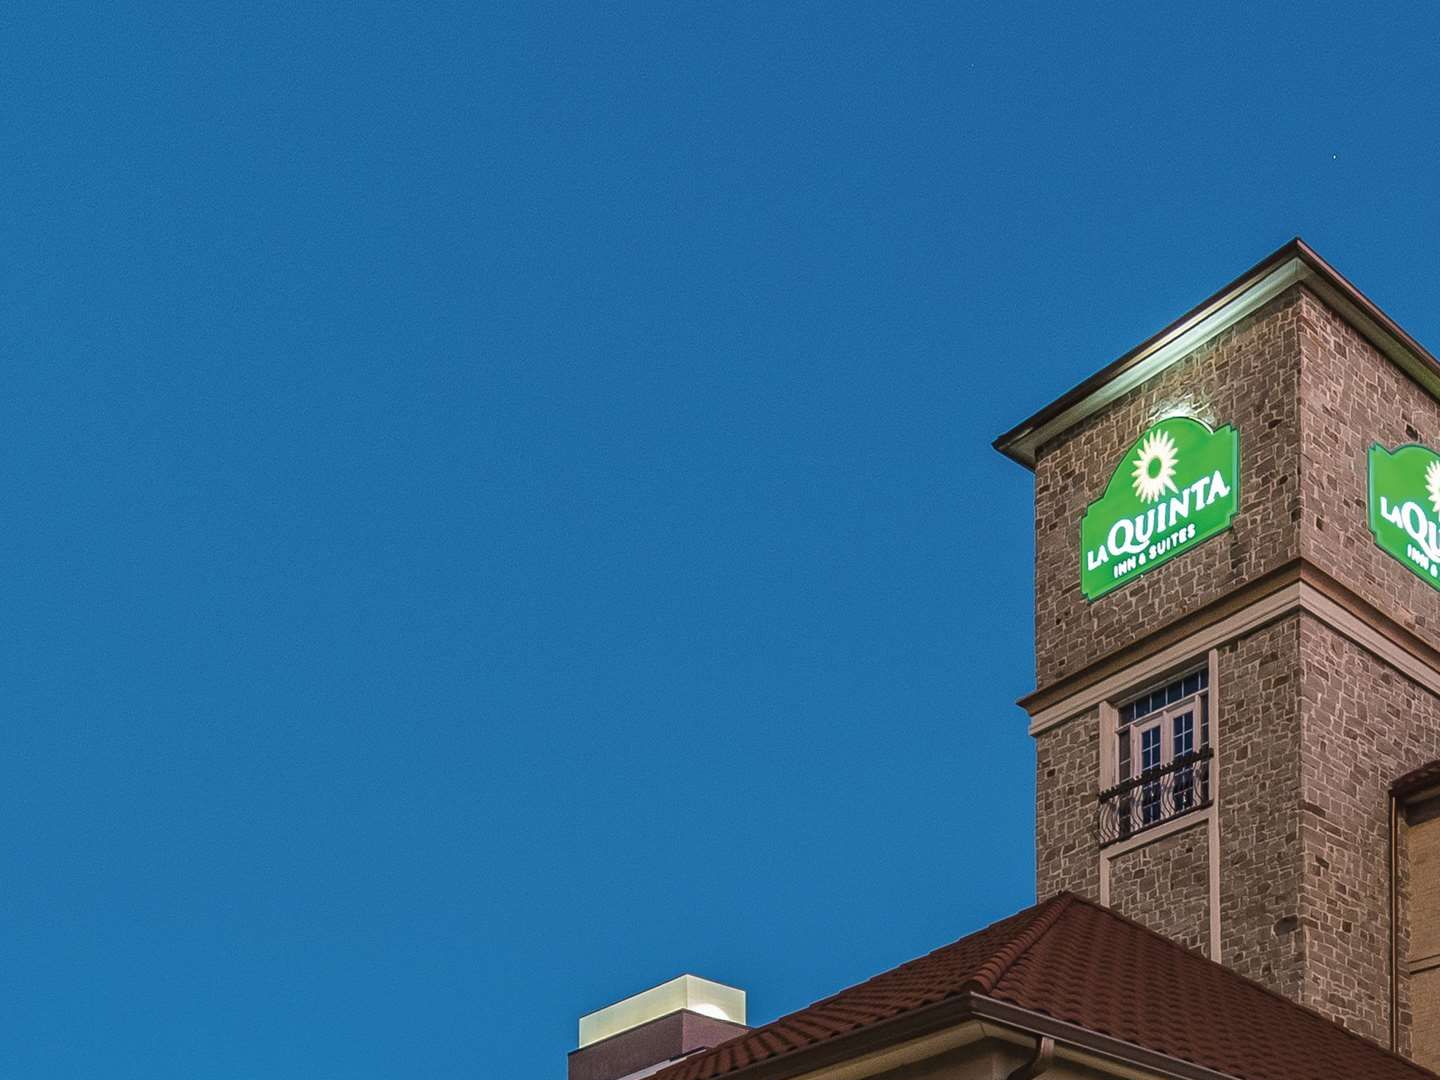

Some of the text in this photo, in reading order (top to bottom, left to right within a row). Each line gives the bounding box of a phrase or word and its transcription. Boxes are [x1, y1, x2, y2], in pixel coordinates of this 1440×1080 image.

[1087, 470, 1231, 571] LA QUINTA
[1380, 496, 1405, 529] LA
[1113, 555, 1137, 578] INN
[1149, 523, 1196, 559] SUITES
[1407, 544, 1430, 571] INN
